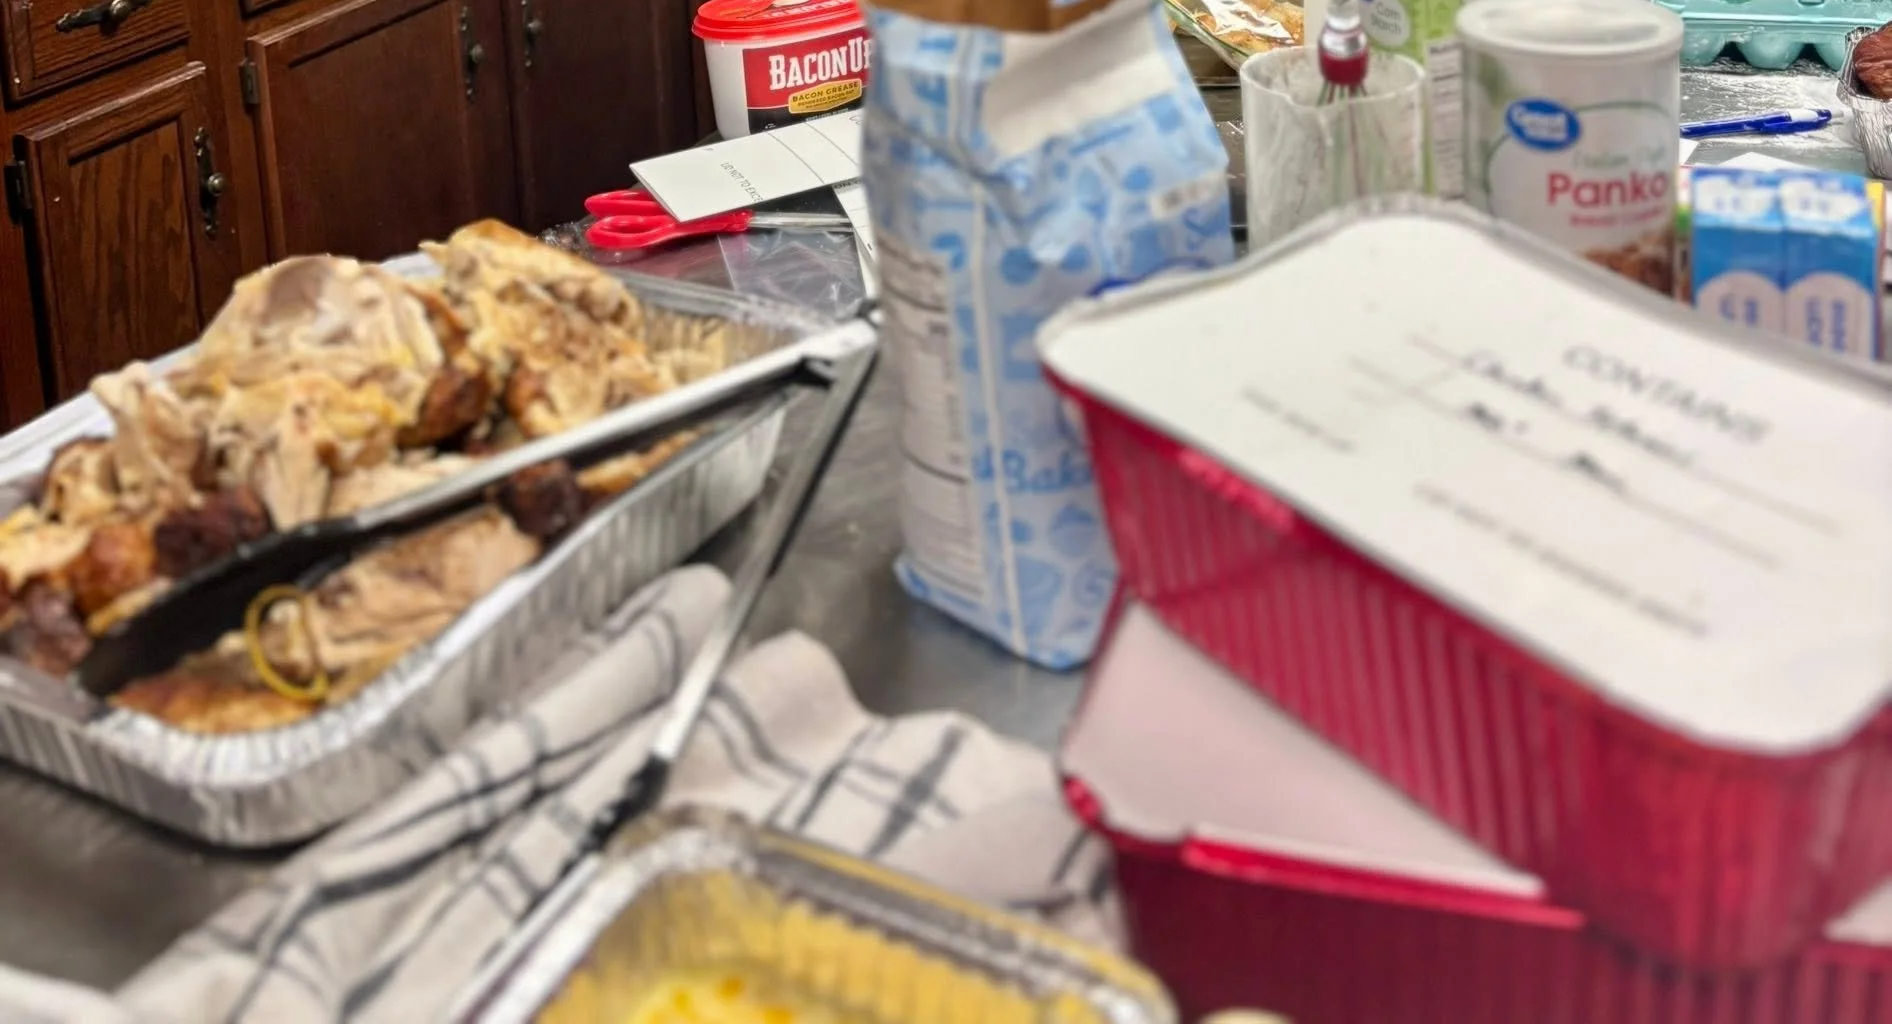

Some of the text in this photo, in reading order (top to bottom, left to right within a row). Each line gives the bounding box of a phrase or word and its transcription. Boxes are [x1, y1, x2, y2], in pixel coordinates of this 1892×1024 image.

[792, 89, 824, 103] BACON
[825, 81, 860, 95] GREASE
[1546, 169, 1669, 208] Panko
